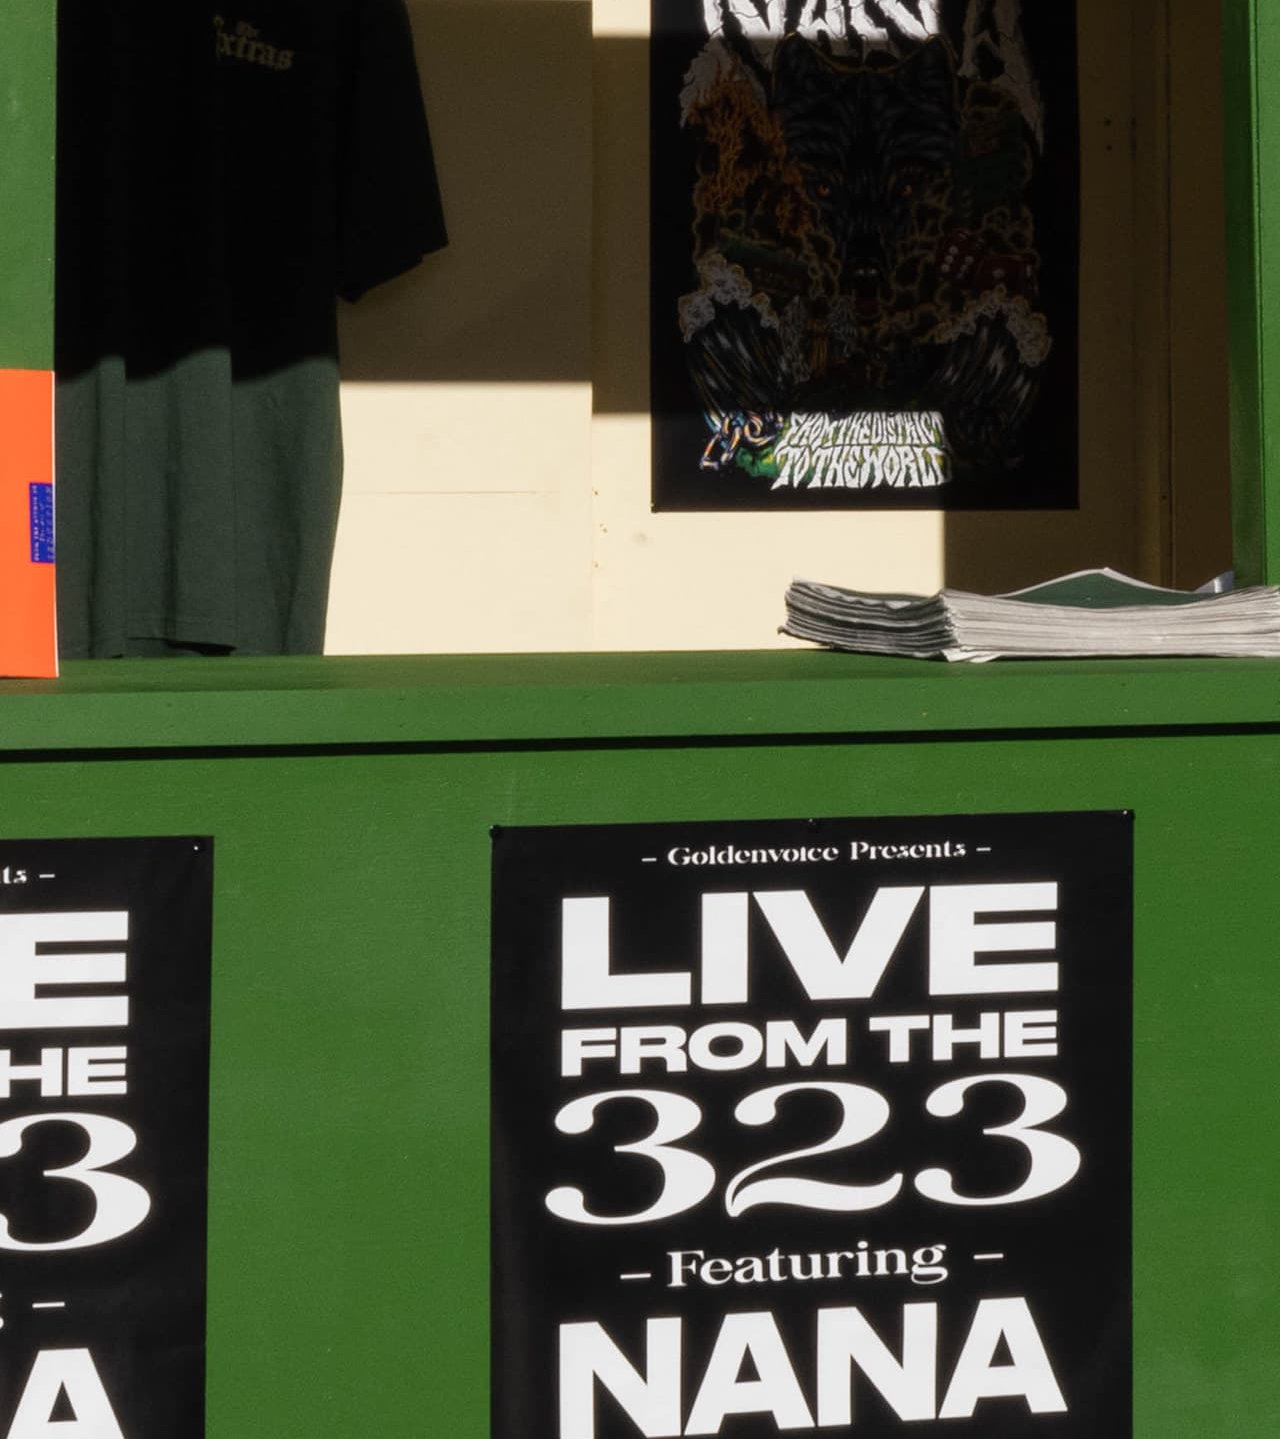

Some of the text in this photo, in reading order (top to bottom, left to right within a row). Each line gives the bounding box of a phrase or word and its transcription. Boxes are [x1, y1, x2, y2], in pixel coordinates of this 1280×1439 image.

[667, 840, 967, 866] Goldenvoice Presents
[561, 881, 1059, 1011] LIVE
[561, 1009, 1059, 1077] FROM THE
[545, 1073, 1081, 1225] 323
[665, 1240, 948, 1288] Featuring
